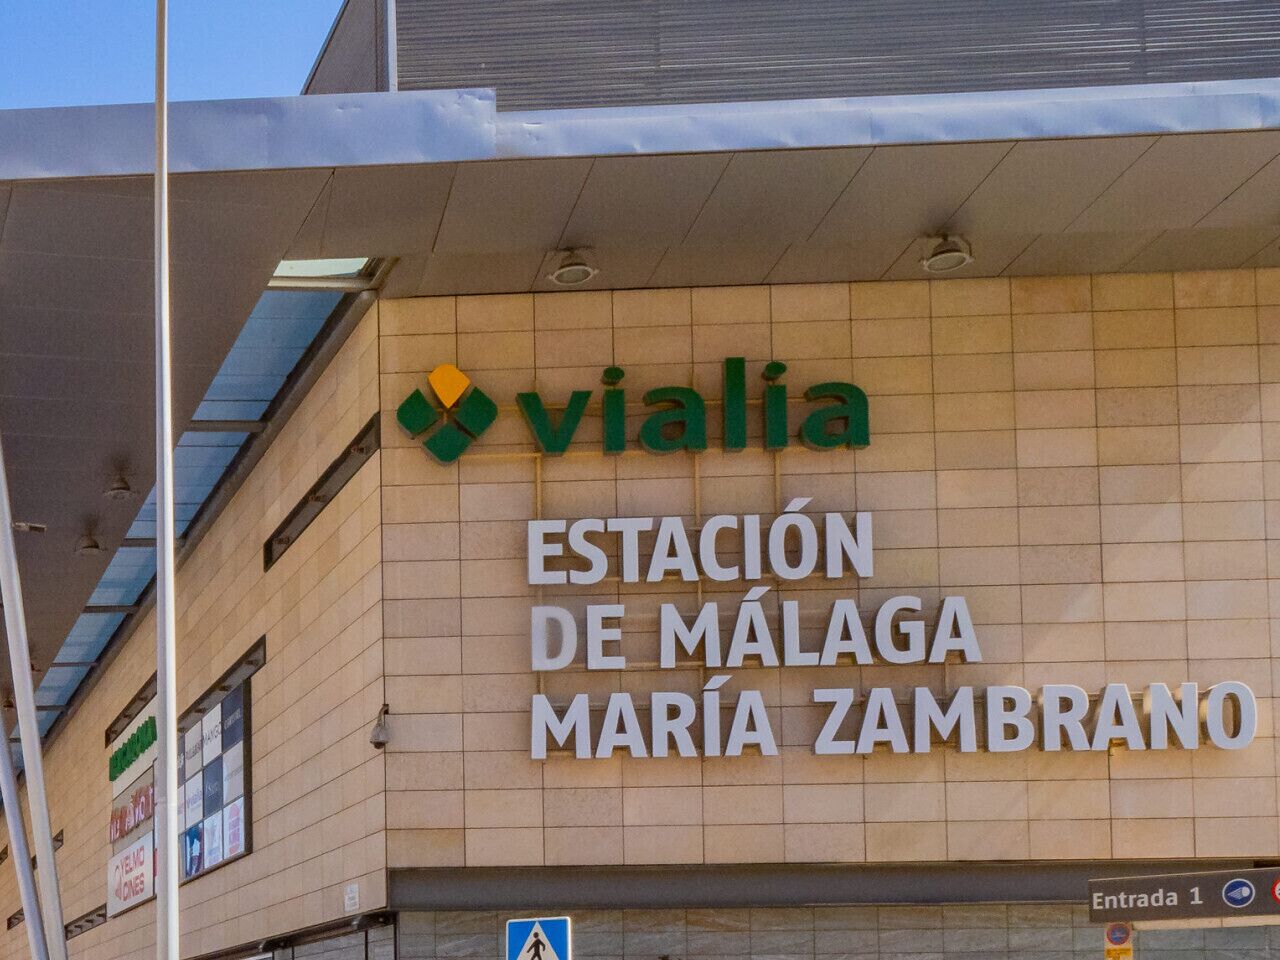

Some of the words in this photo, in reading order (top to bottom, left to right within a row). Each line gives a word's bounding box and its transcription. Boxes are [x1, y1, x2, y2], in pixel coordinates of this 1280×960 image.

[517, 356, 871, 456] vialia
[527, 497, 875, 585] ESTACIÓN
[531, 604, 626, 672] DE
[660, 586, 983, 670] MÁLAGA
[531, 675, 780, 760] MARÍA
[813, 680, 1259, 756] ZAMBRANO
[1092, 889, 1178, 910] Entrada
[1189, 887, 1204, 905] 1
